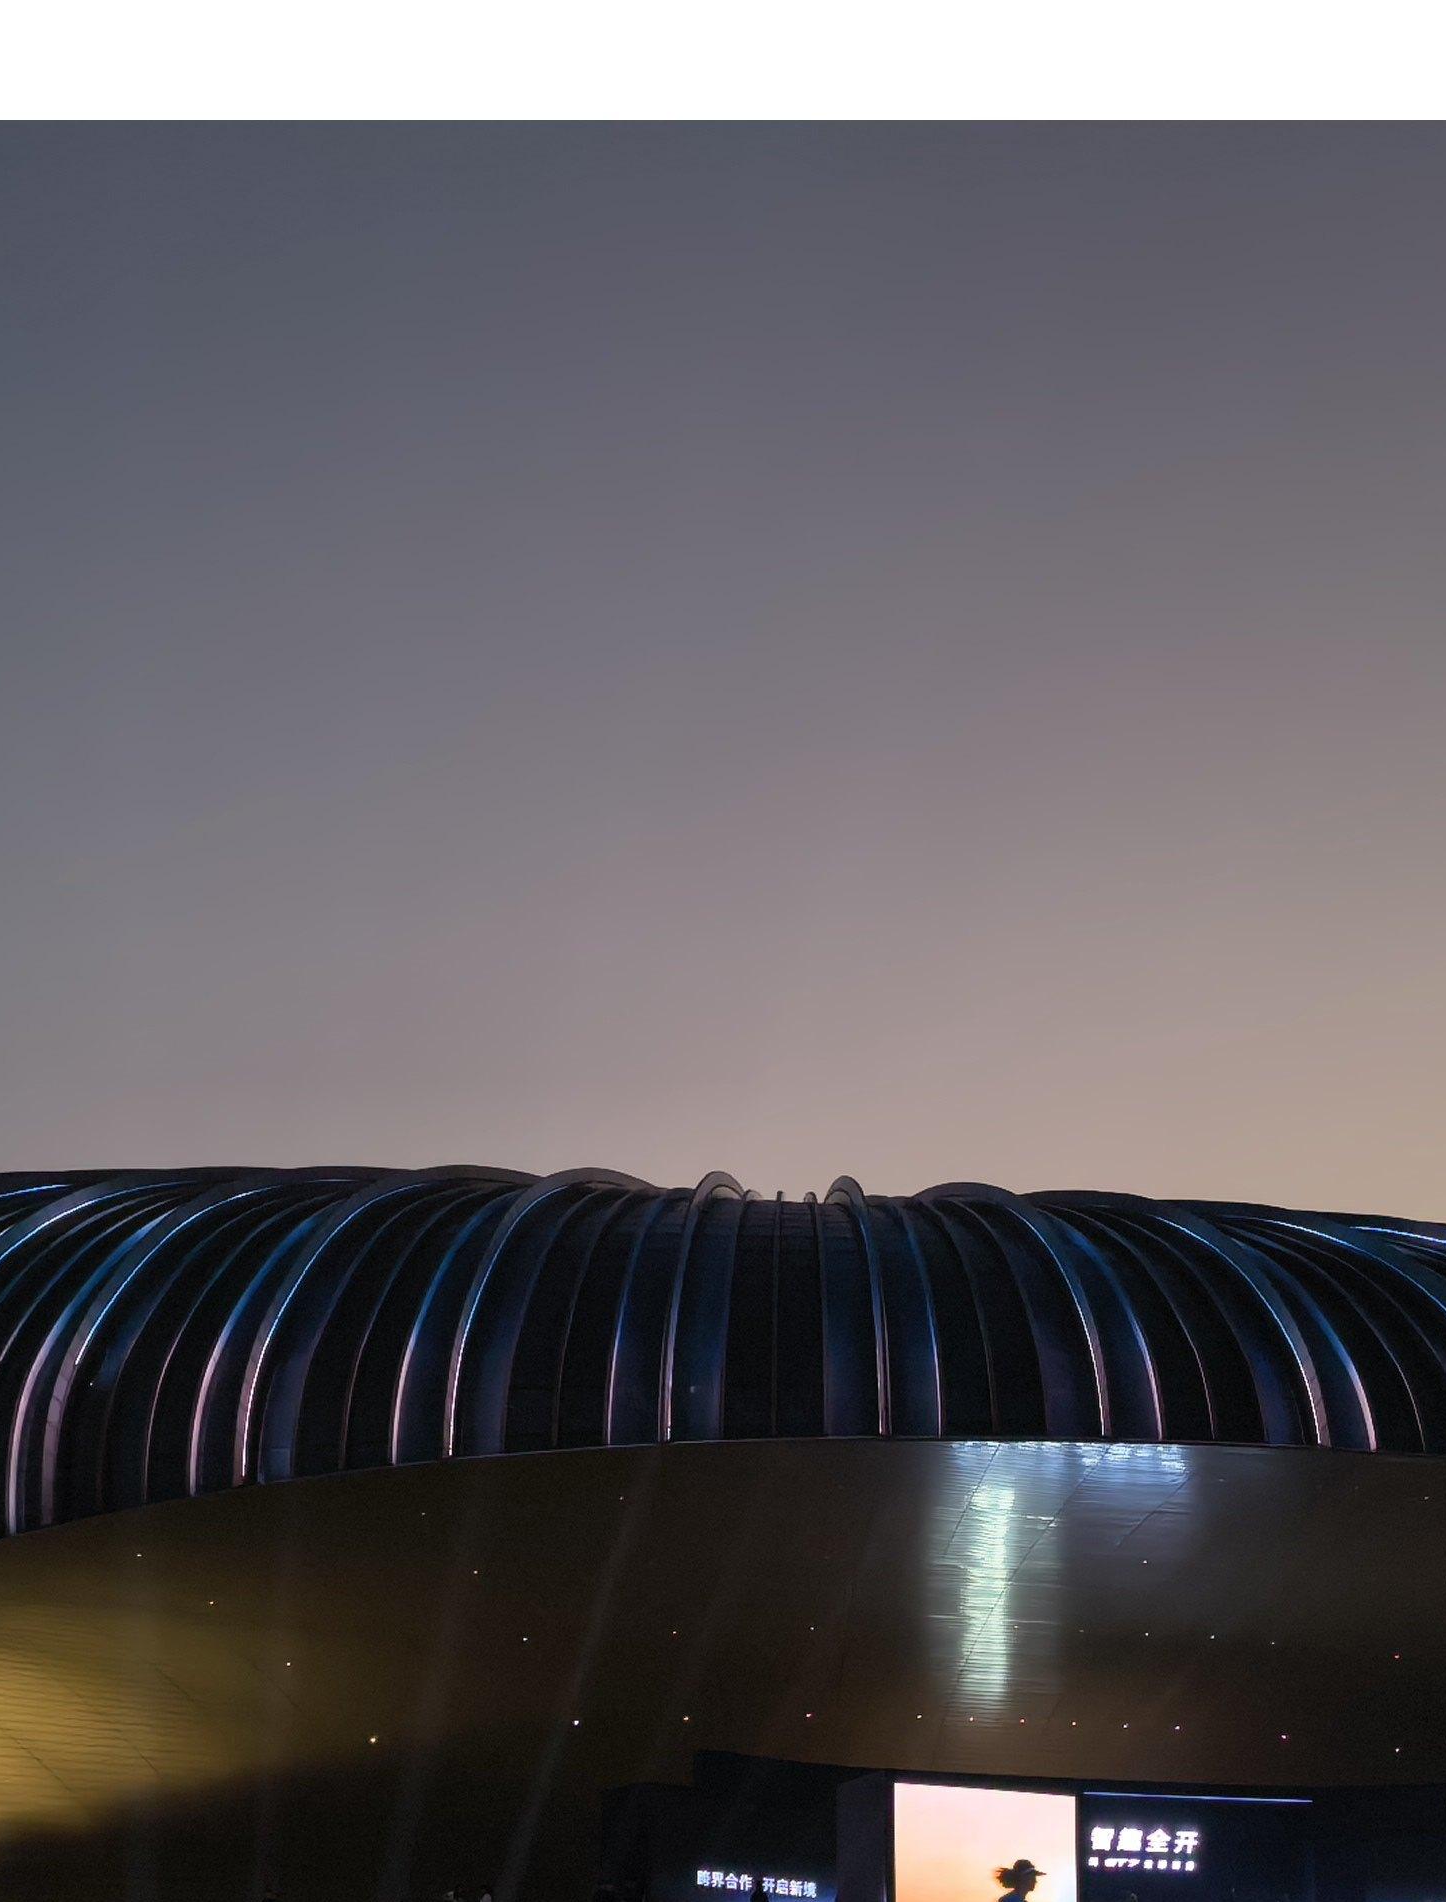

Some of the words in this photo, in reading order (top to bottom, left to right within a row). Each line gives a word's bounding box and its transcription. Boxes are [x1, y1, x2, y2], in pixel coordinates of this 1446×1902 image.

[696, 1868, 753, 1892] 跨界合作
[761, 1876, 817, 1899] 开启新境
